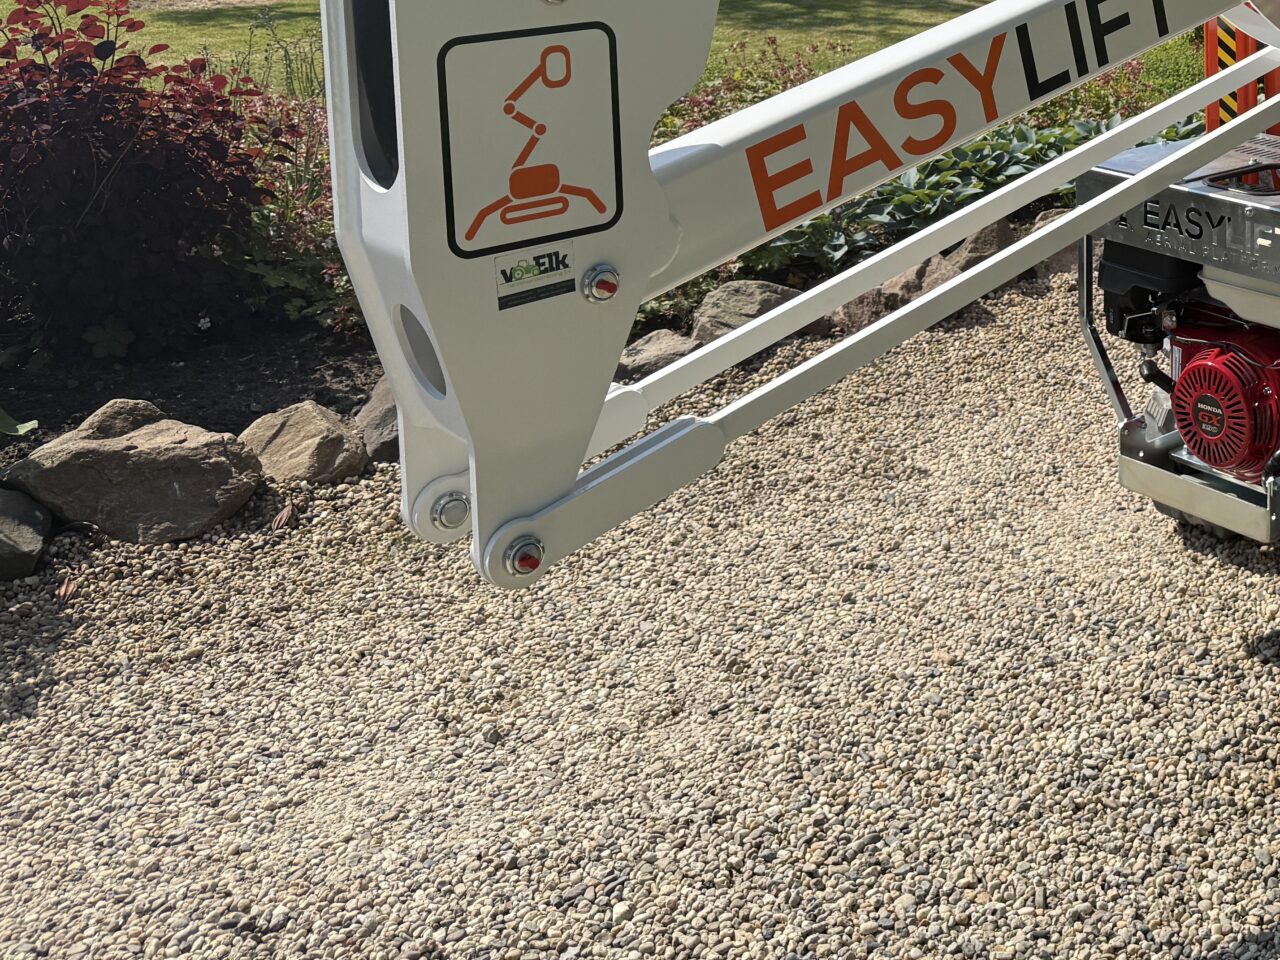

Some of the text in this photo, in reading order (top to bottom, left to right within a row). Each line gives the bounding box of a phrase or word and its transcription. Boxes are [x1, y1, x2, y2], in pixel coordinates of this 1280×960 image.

[1144, 231, 1196, 255] AERIAL
[533, 250, 570, 274] Elk
[1197, 402, 1223, 415] HONDA
[1198, 411, 1221, 427] GX
